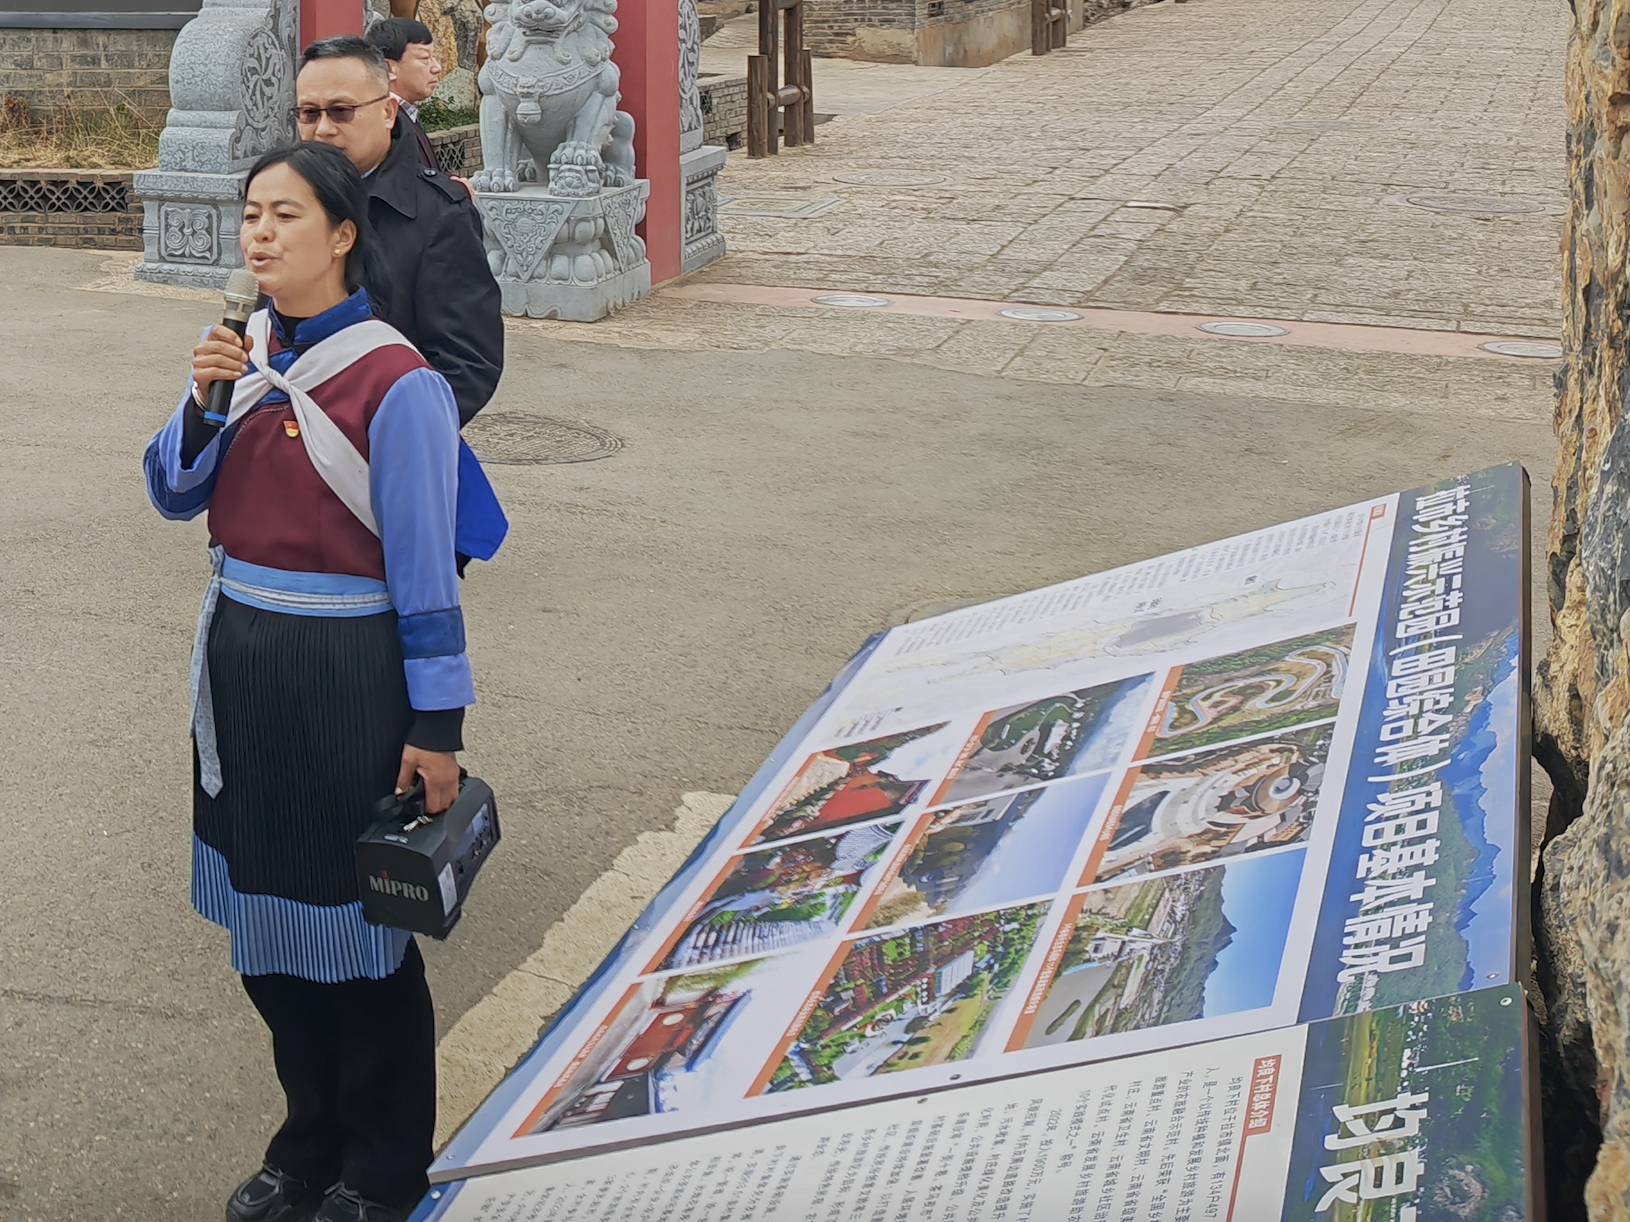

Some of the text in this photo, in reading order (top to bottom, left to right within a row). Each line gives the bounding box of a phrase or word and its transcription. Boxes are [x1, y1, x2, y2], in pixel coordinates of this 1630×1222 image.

[1248, 1058, 1277, 1130] 均良下村总体介绍
[1315, 1092, 1430, 1222] 均良
